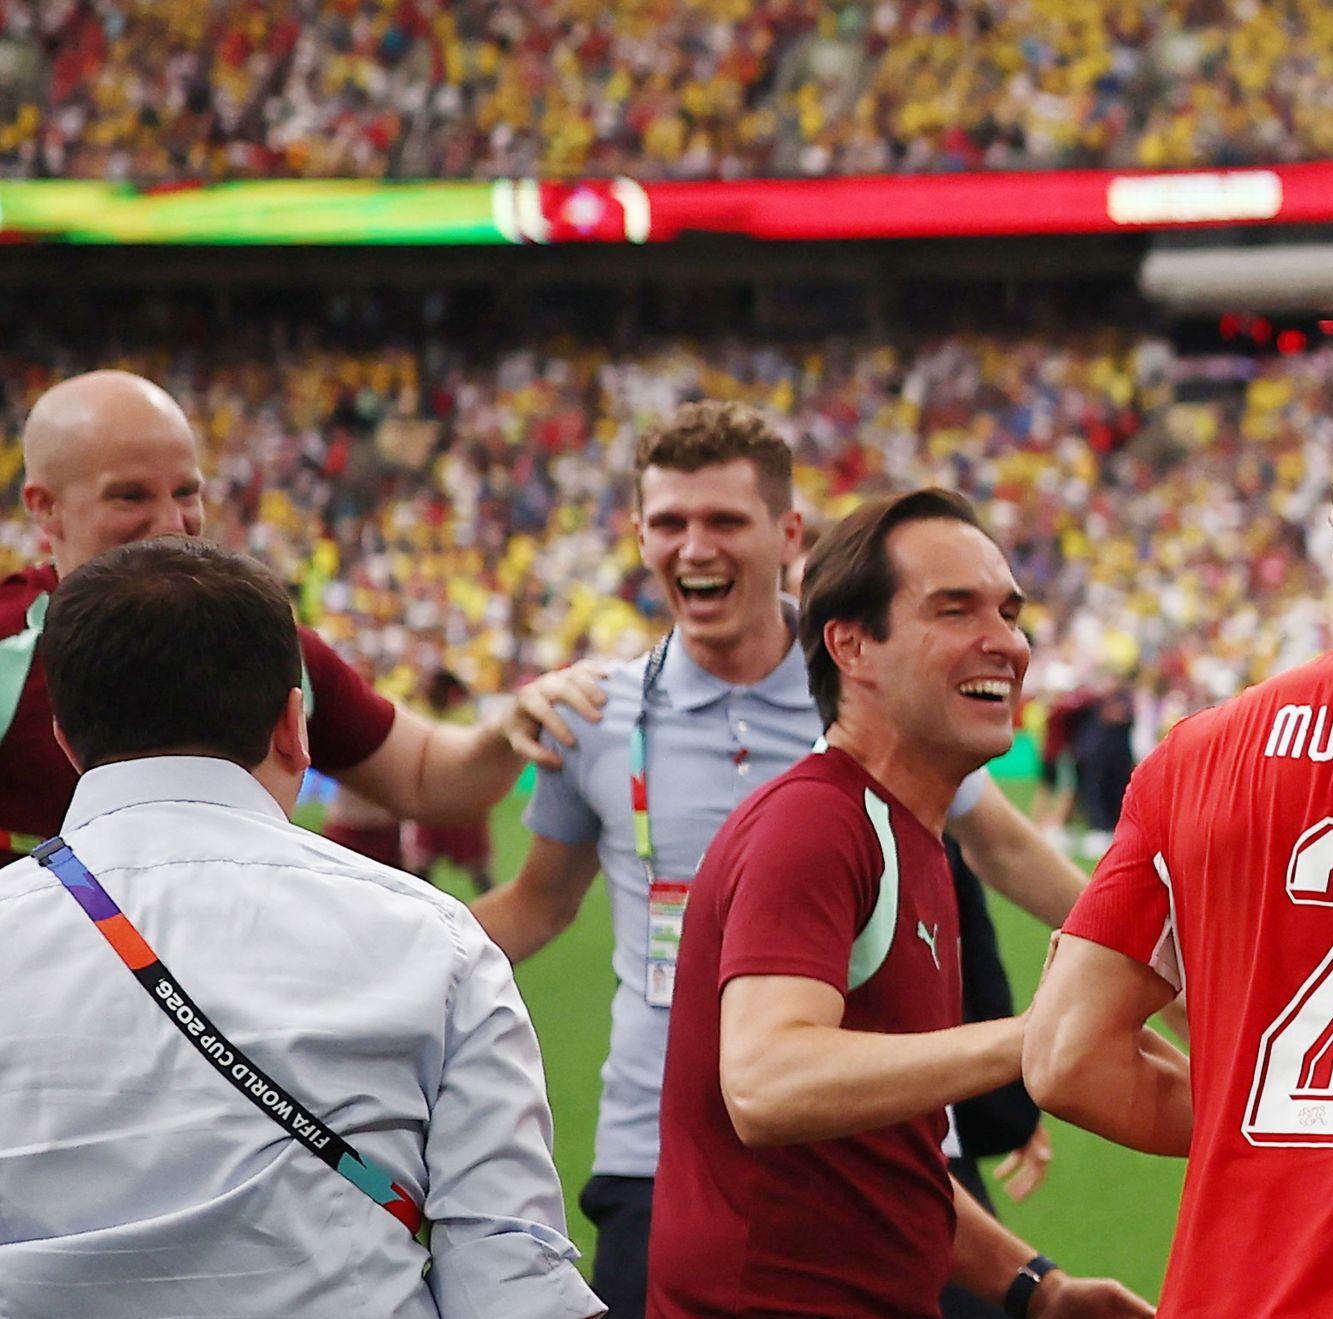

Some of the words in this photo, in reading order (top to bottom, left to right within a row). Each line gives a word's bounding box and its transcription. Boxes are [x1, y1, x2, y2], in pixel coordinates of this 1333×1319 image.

[199, 1035, 235, 1067] CUP
[231, 1063, 294, 1121] WORLD
[291, 1112, 331, 1149] FIFA
